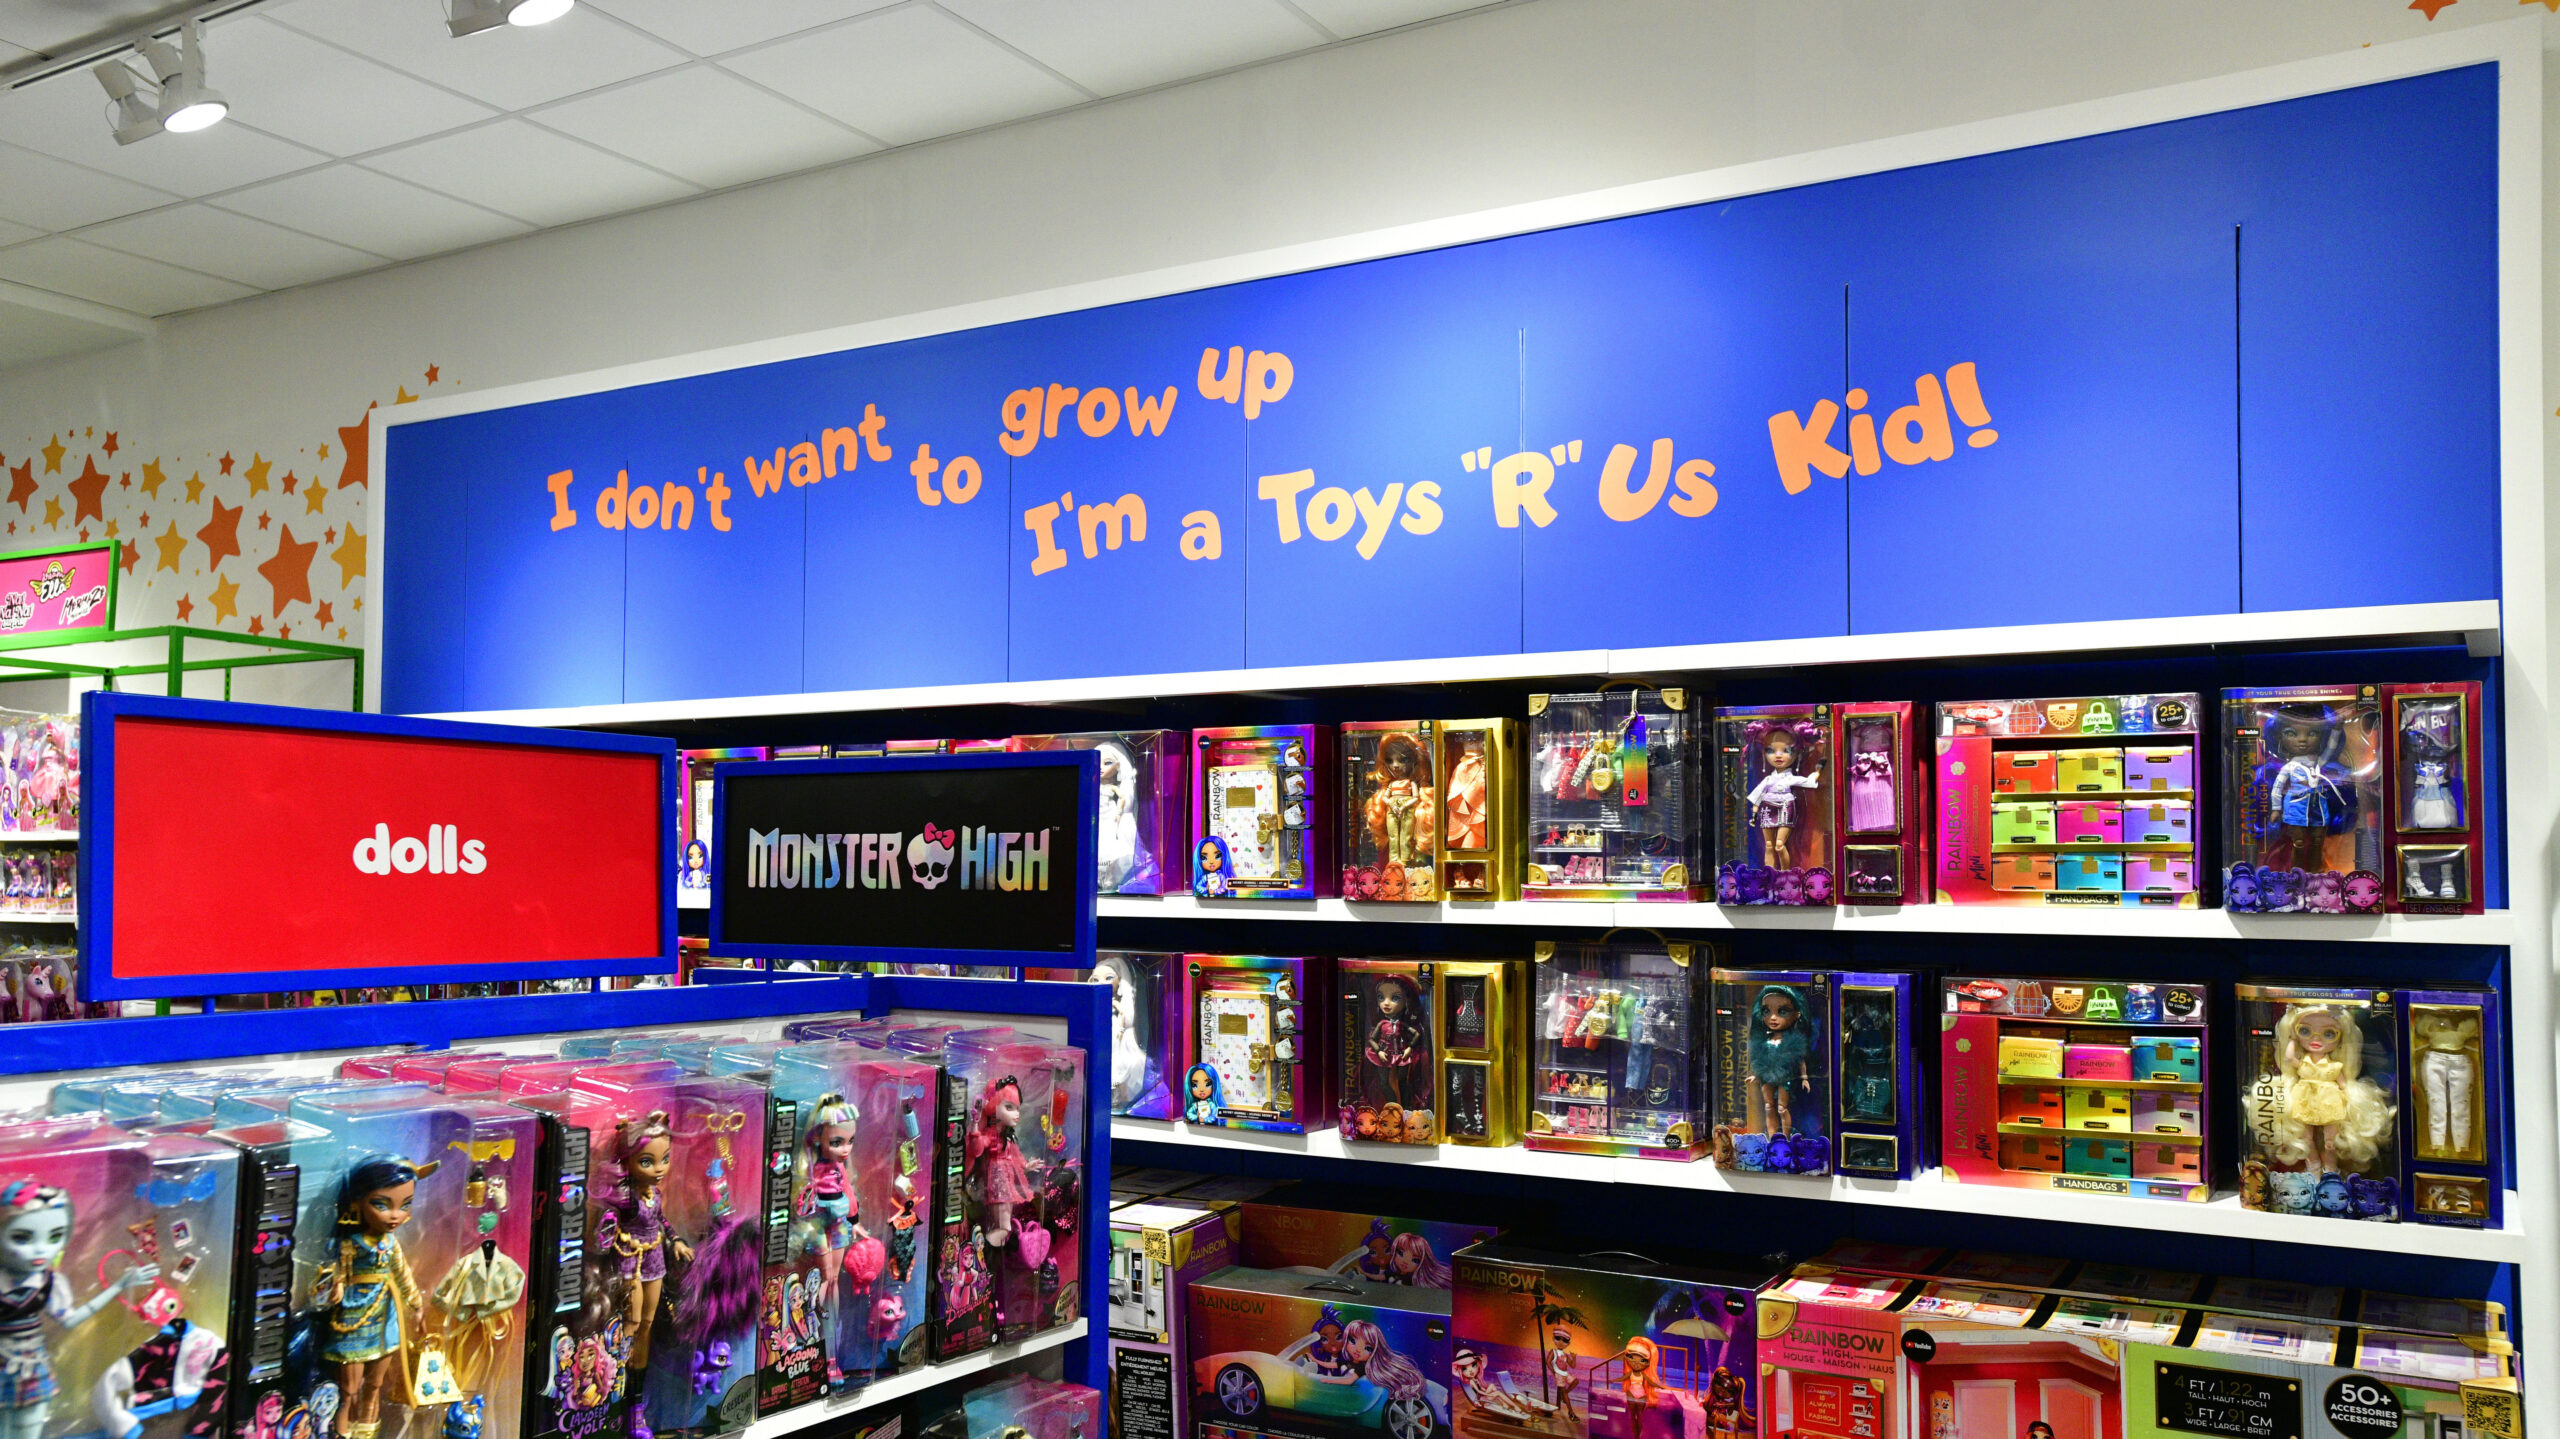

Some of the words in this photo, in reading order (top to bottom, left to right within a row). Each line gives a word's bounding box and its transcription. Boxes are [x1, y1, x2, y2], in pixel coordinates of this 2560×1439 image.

[547, 469, 577, 532] I
[596, 466, 732, 532] don't
[744, 403, 892, 498] want
[910, 444, 982, 506] to
[999, 383, 1178, 457] grow
[1197, 346, 1294, 420] up
[1024, 491, 1147, 577] I'm
[1180, 510, 1222, 561] a
[1258, 468, 1443, 560] Toys
[1461, 440, 1582, 528] "R"
[1598, 438, 1719, 522] Us
[1768, 361, 1998, 496] Kid!
[2159, 702, 2182, 718] 25+
[1212, 767, 1221, 821] RAINBOW
[2260, 784, 2268, 813] HIGH
[1948, 789, 1961, 871] RAINBOW
[353, 822, 487, 875] dolls
[748, 827, 902, 889] MONSTER
[960, 824, 1049, 891] HIGH
[2055, 894, 2109, 904] HANDBAGS
[2170, 991, 2193, 1004] 25+
[1204, 992, 1213, 1046] RAINBOW
[1345, 1012, 1355, 1088] RAINBOW
[1721, 1028, 1734, 1113] RAINBOW
[948, 1079, 966, 1121] HIGH
[1954, 1066, 1968, 1149] RAINBOW
[773, 1104, 796, 1151] HIGH
[559, 1131, 588, 1183] HIGH
[945, 1144, 963, 1224] MONSTER
[2063, 1179, 2118, 1191] HANDBAGS
[767, 1175, 791, 1264] MONSTER
[555, 1211, 583, 1313] MONSTER
[1191, 1239, 1228, 1262] RAINBOW
[1461, 1266, 1537, 1290] RAINBOW
[1197, 1294, 1265, 1315] RAINBOW
[1790, 1327, 1885, 1353] RAINBOW
[776, 1346, 820, 1373] LAGOONA
[788, 1360, 810, 1379] BLUE
[1784, 1352, 1815, 1363] HOUSE
[1824, 1357, 1861, 1369] MAISON
[1869, 1364, 1895, 1374] HAUS
[2174, 1376, 2184, 1388] 4
[2190, 1379, 2206, 1391] FT
[2259, 1391, 2271, 1400] m
[2188, 1391, 2206, 1400] TALL
[2212, 1394, 2234, 1404] HAUT
[2242, 1398, 2267, 1409] HOCH
[2341, 1383, 2392, 1406] 50+
[558, 1403, 610, 1432] CLAWDEEN
[1808, 1413, 1836, 1422] FASHION
[1809, 1401, 1836, 1410] ALWAYS
[2184, 1402, 2194, 1417] 3
[2198, 1407, 2215, 1419] FT
[2227, 1408, 2245, 1423] 91
[2250, 1415, 2273, 1428] CM
[2330, 1403, 2398, 1419] ACCESSORIES
[2185, 1418, 2208, 1427] WIDE
[2214, 1420, 2241, 1432] LARGE
[2247, 1426, 2272, 1436] BREIT
[2330, 1412, 2399, 1429] ACCESSOIRES
